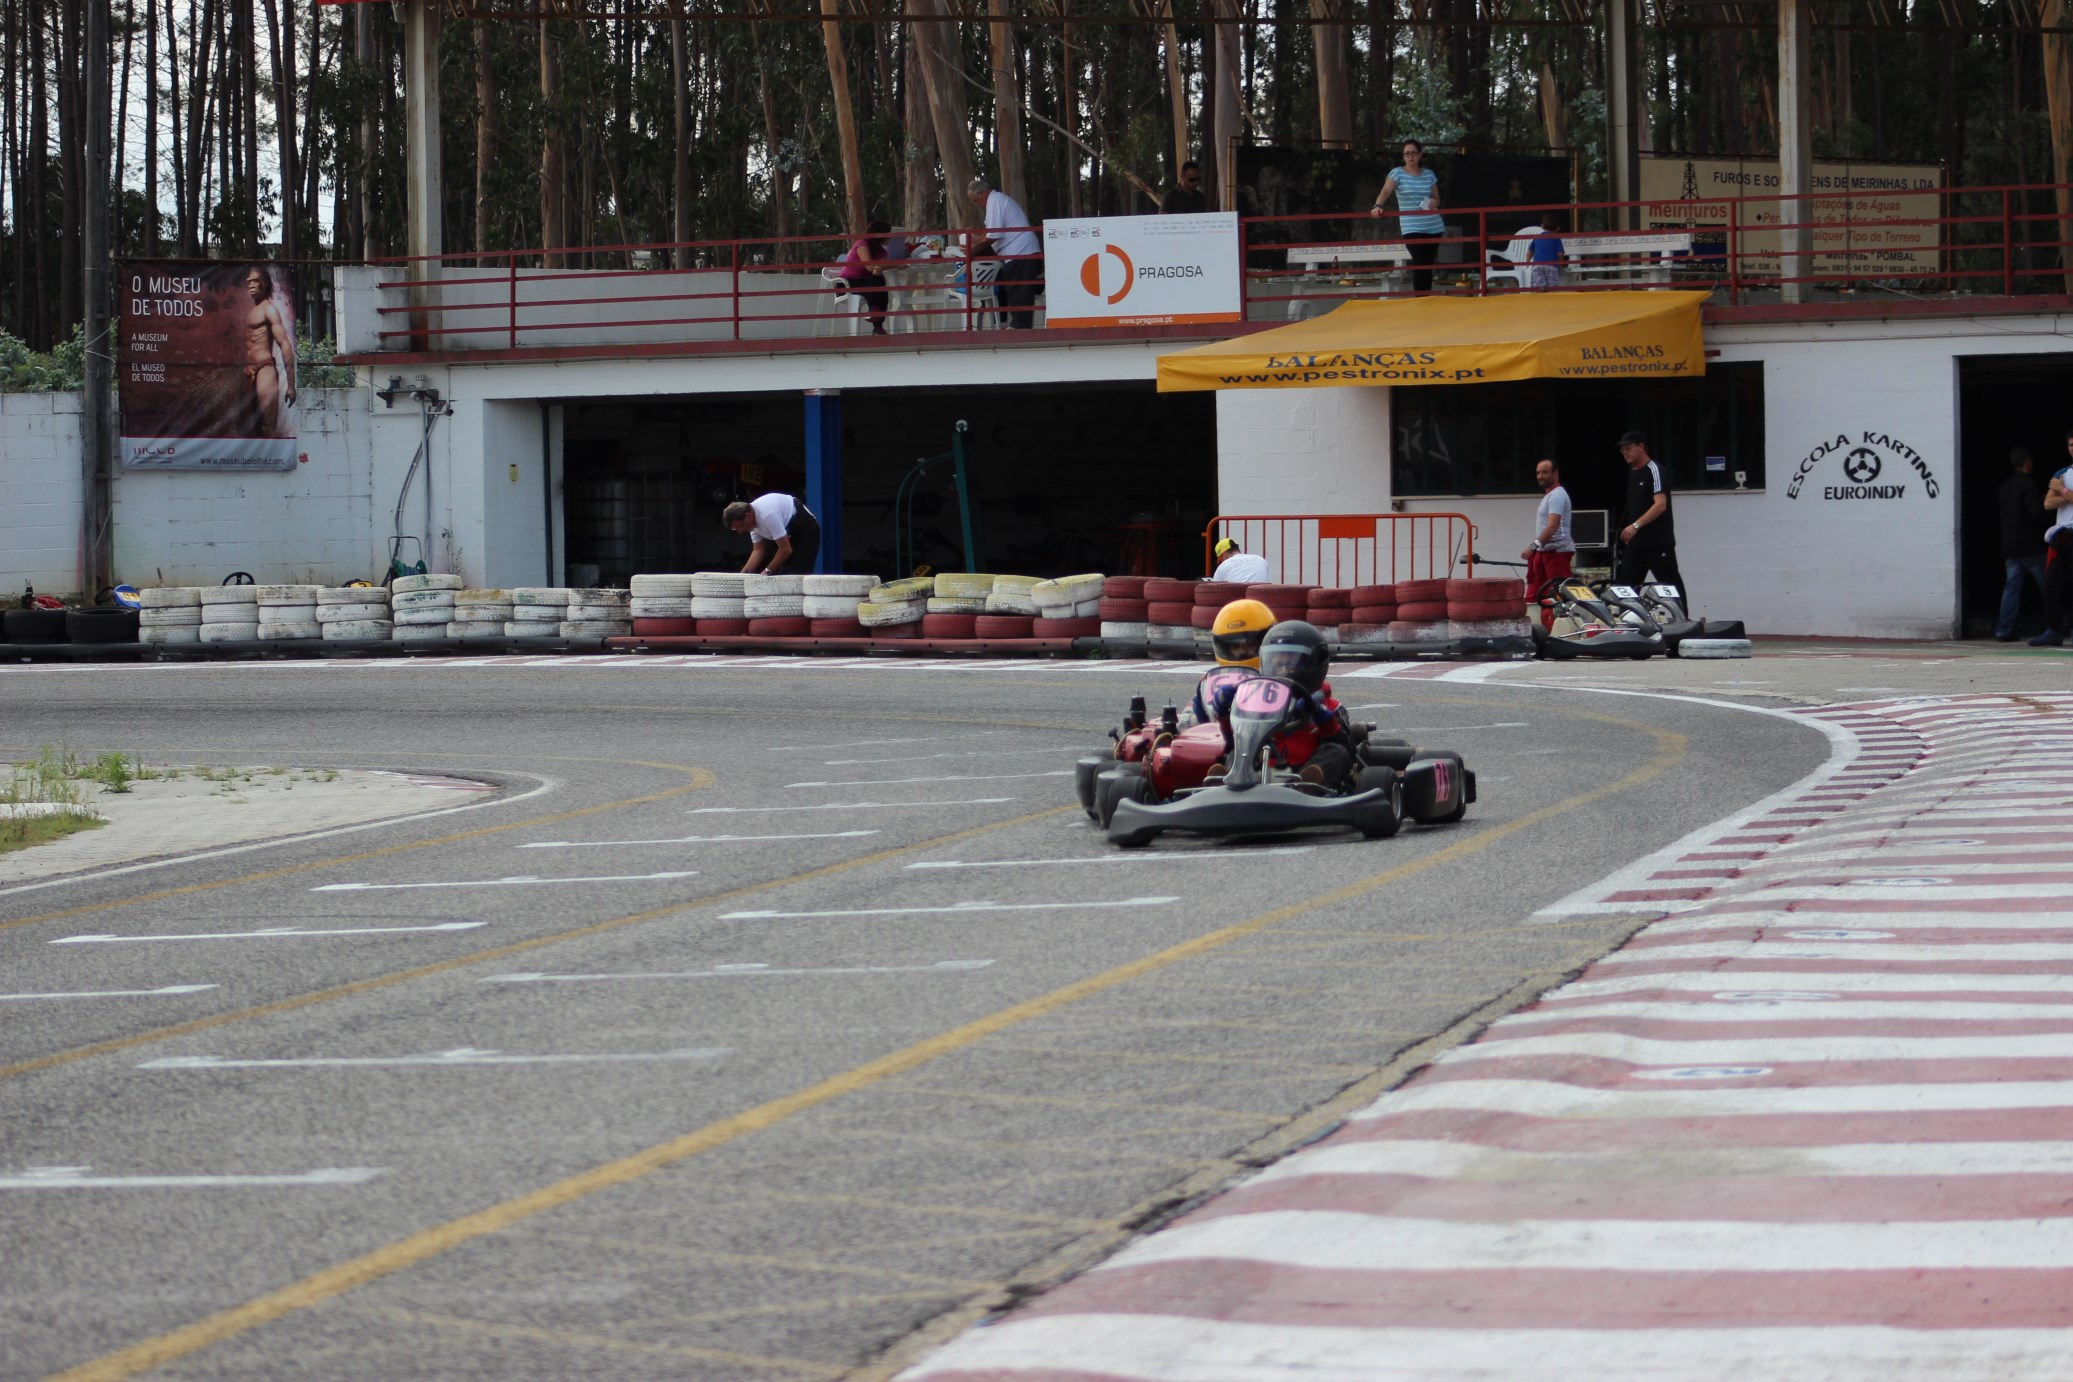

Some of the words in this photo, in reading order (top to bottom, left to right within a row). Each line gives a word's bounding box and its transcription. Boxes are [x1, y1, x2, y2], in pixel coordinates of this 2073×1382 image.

[1713, 172, 1751, 186] FUROS
[1754, 175, 1761, 186] E
[1834, 177, 1849, 188] DE
[1856, 200, 1867, 210] de
[1870, 197, 1901, 212] Águas
[1813, 231, 1844, 244] alquer
[1847, 230, 1867, 244] Tipo
[1870, 232, 1882, 242] de
[1885, 231, 1921, 242] Terreno
[1877, 252, 1917, 262] POMBAL
[1139, 265, 1203, 279] PRAGOSA
[132, 275, 141, 293] O
[149, 277, 201, 294] MUSEU
[132, 298, 150, 316] DE
[155, 299, 204, 316] TODOS
[1118, 316, 1173, 326] www.pragosa.pt
[131, 333, 137, 342] A
[138, 333, 168, 342] MUSEUM
[131, 343, 145, 352] FOR
[146, 344, 158, 352] ALL
[1581, 345, 1664, 361] BALANÇAS
[132, 363, 139, 371] EL
[141, 363, 165, 372] MUSEO
[1219, 366, 1486, 384] www.pestronix.pt
[132, 373, 142, 382] DE
[143, 374, 165, 382] TODOS
[1787, 434, 1850, 500] ESCOLA
[1863, 431, 1940, 499] KARTING
[1824, 485, 1905, 500] EUROINDY
[1241, 681, 1279, 703] 76
